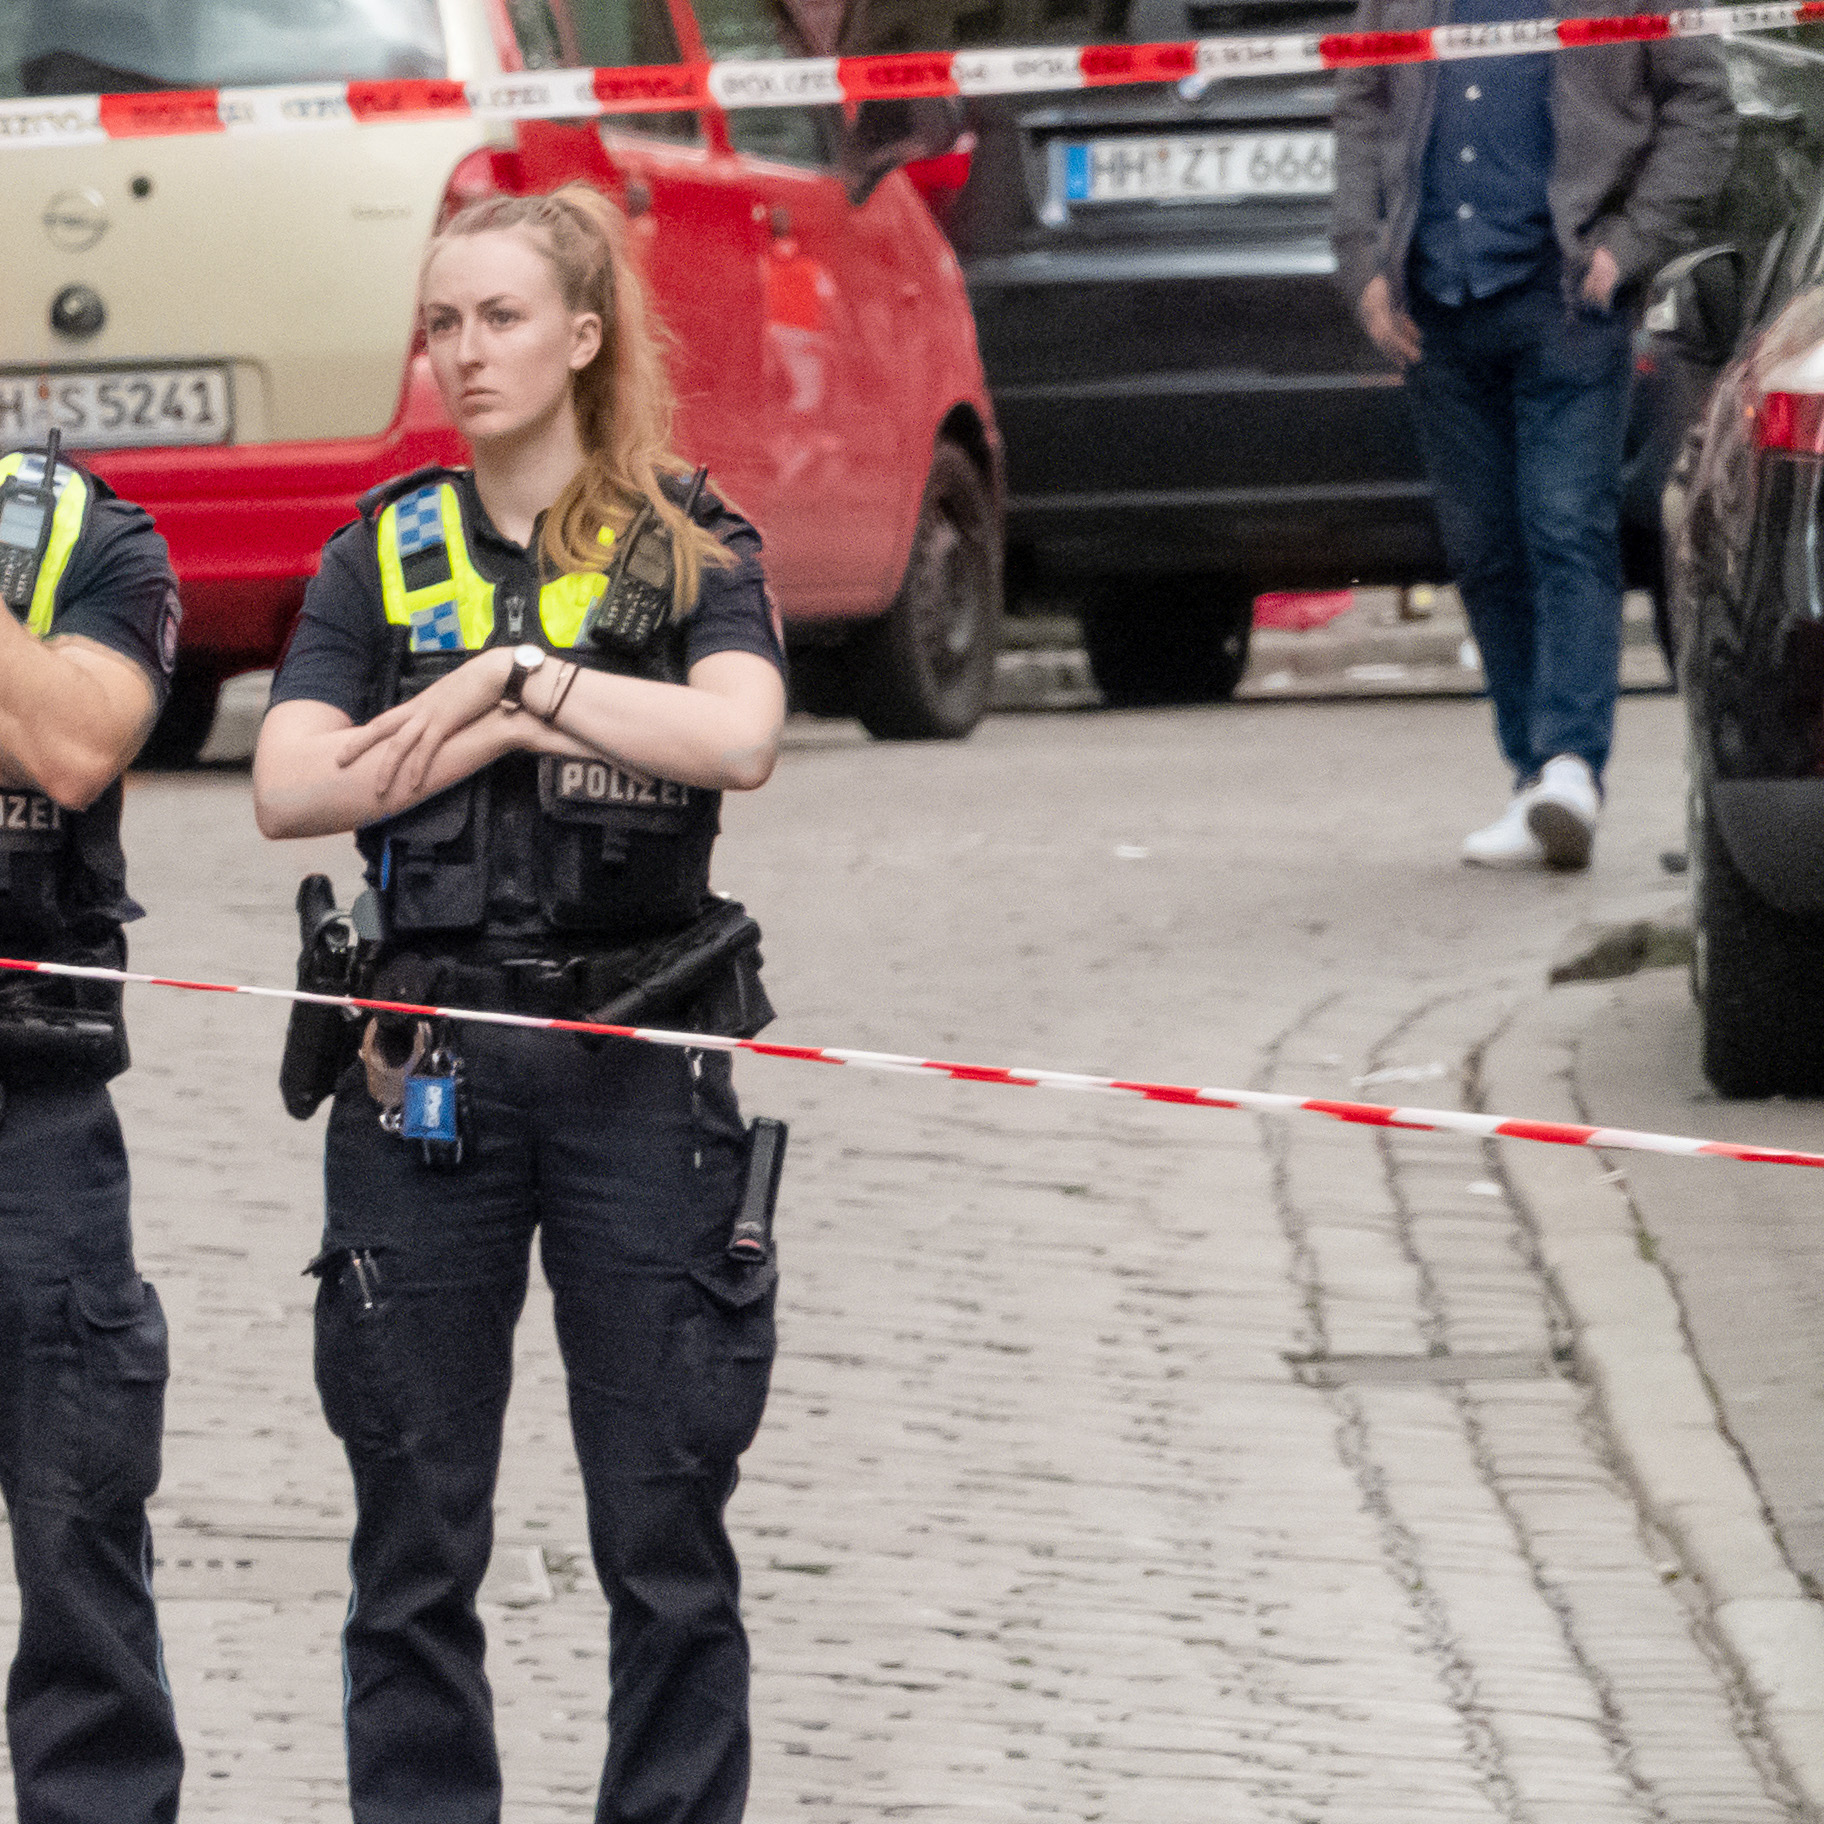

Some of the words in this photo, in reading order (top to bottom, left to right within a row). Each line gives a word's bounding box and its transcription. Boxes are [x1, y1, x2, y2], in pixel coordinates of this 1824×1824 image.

[1180, 145, 1232, 188] ZT
[1248, 140, 1330, 183] 666
[58, 384, 87, 429] S
[97, 378, 214, 428] 5241
